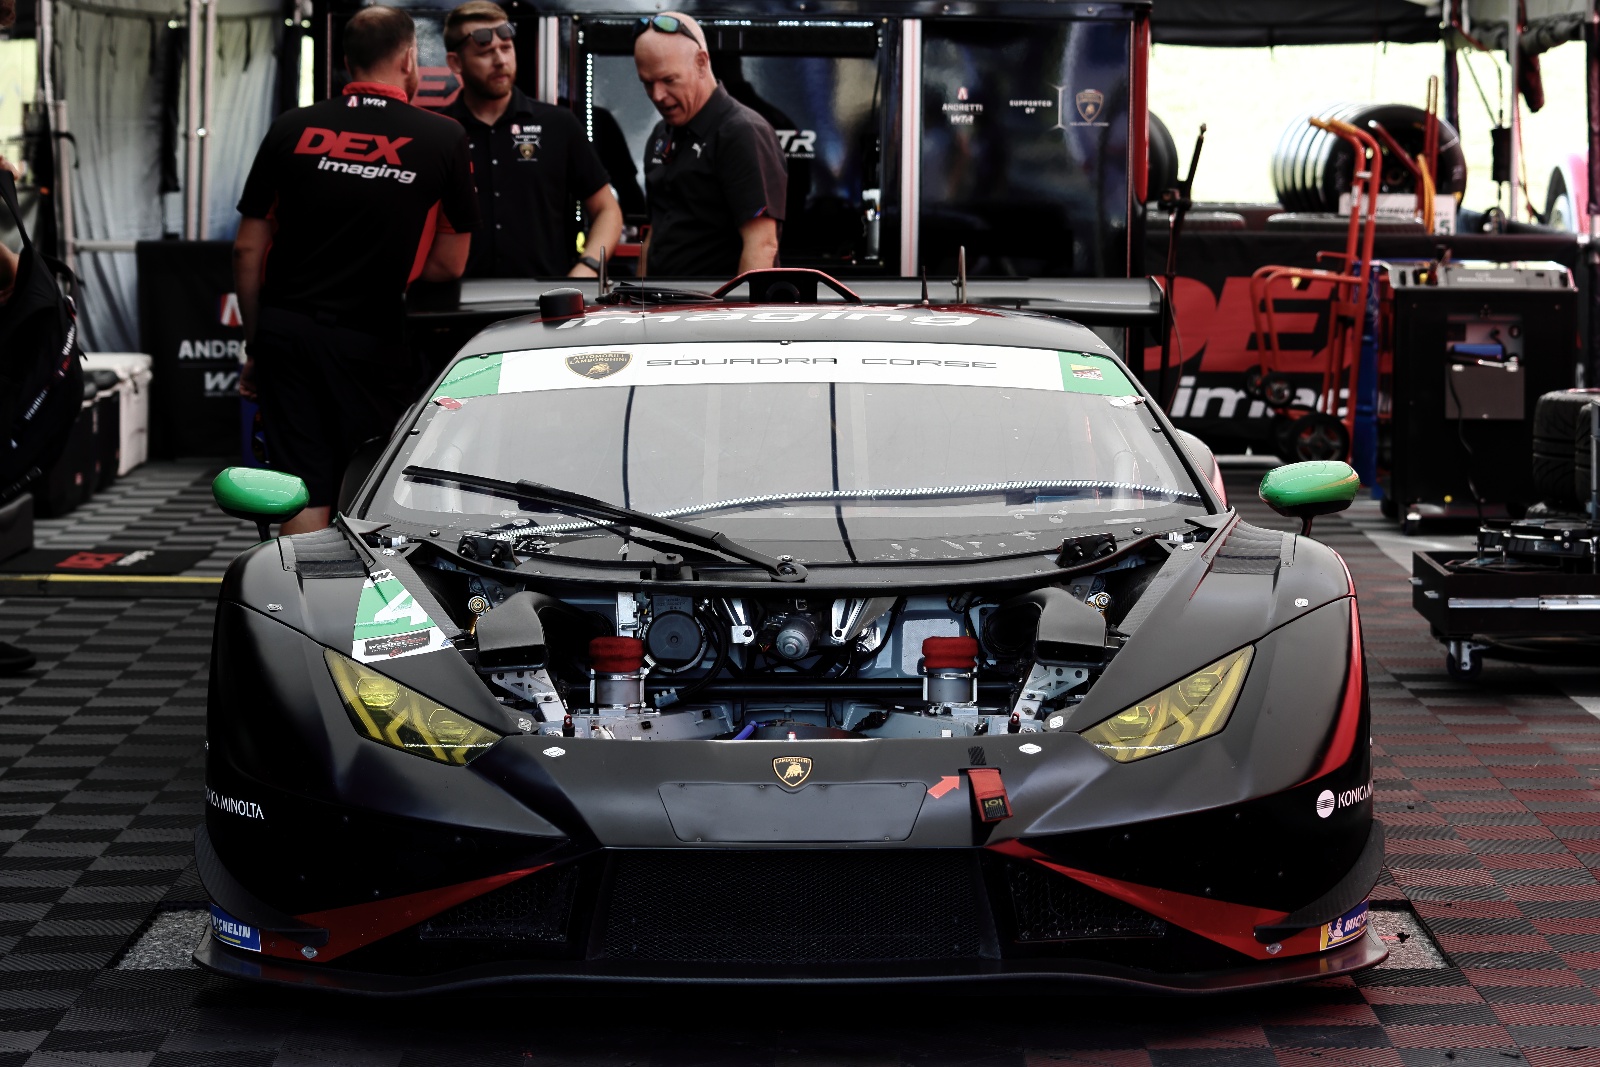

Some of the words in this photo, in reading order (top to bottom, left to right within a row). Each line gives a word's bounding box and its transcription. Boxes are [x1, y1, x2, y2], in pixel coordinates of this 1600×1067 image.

[941, 103, 983, 112] ANDRETTI
[293, 126, 414, 165] DEX
[775, 130, 816, 152] TR
[317, 157, 417, 184] imaging
[555, 310, 979, 330] imaging
[179, 340, 241, 359] ANDR
[646, 357, 837, 366] SQUADRA
[861, 358, 997, 369] CORSE
[220, 795, 265, 820] MINOLTA
